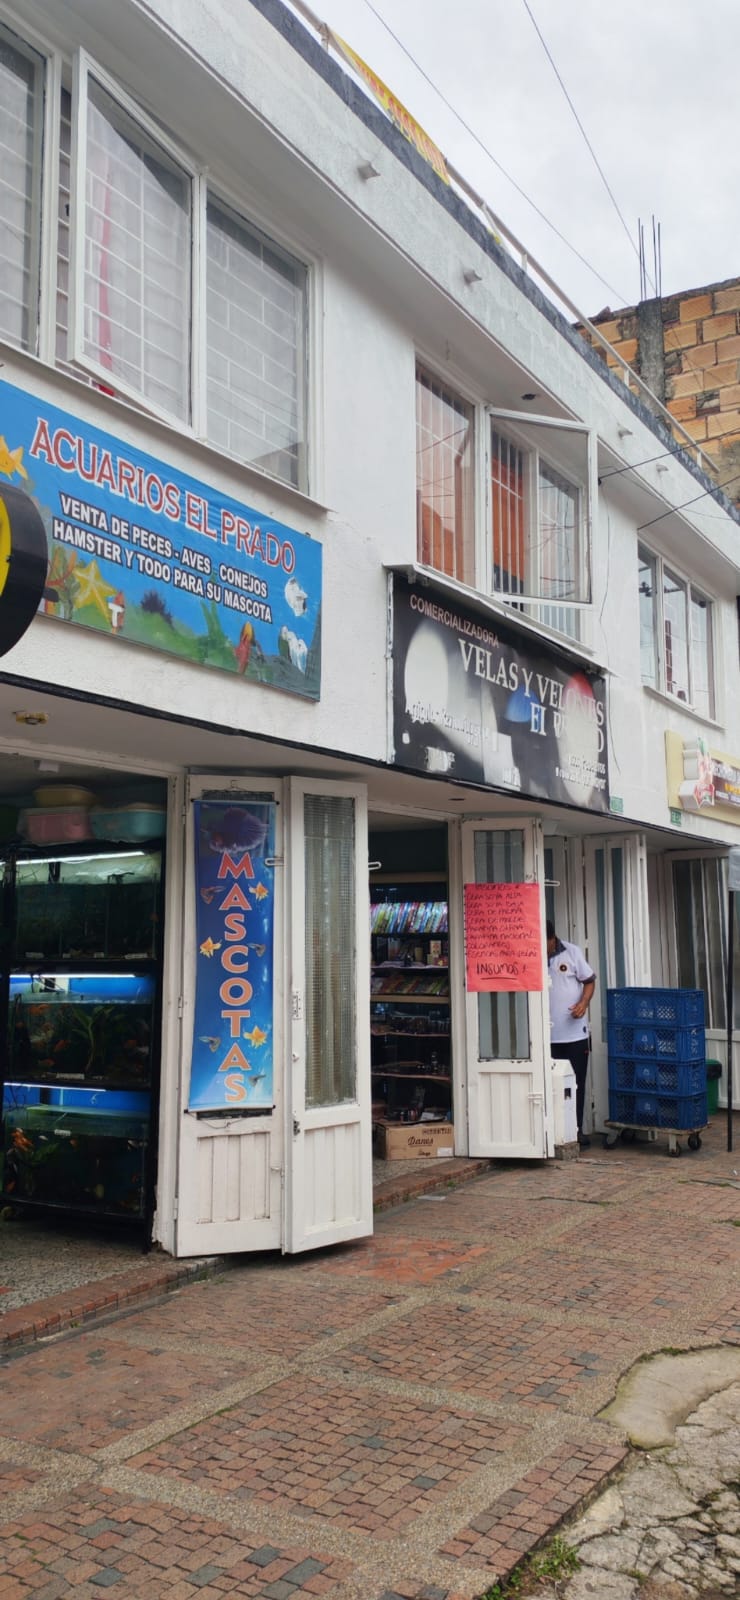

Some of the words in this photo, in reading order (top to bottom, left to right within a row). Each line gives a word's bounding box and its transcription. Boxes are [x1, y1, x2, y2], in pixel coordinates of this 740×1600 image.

[30, 416, 182, 523] ACUARIOS
[185, 489, 217, 540] EL
[220, 509, 295, 574] PRADO
[60, 494, 108, 531] VENTA
[111, 514, 129, 541] DE
[132, 522, 172, 558] PECES
[181, 547, 211, 575] AVES
[219, 562, 267, 598] CONEJOS
[53, 518, 121, 564] HAMSTER
[125, 547, 134, 568] Y
[137, 553, 170, 582] TODO
[174, 568, 204, 597] PARA
[206, 582, 221, 602] SU
[224, 590, 272, 623] MASCOTA
[409, 594, 500, 648] COMERCIALIZADORA
[458, 638, 519, 691] VELAS
[522, 667, 534, 697] Y
[217, 851, 255, 1103] MASCOTAS
[476, 962, 519, 975] INSUMOS
